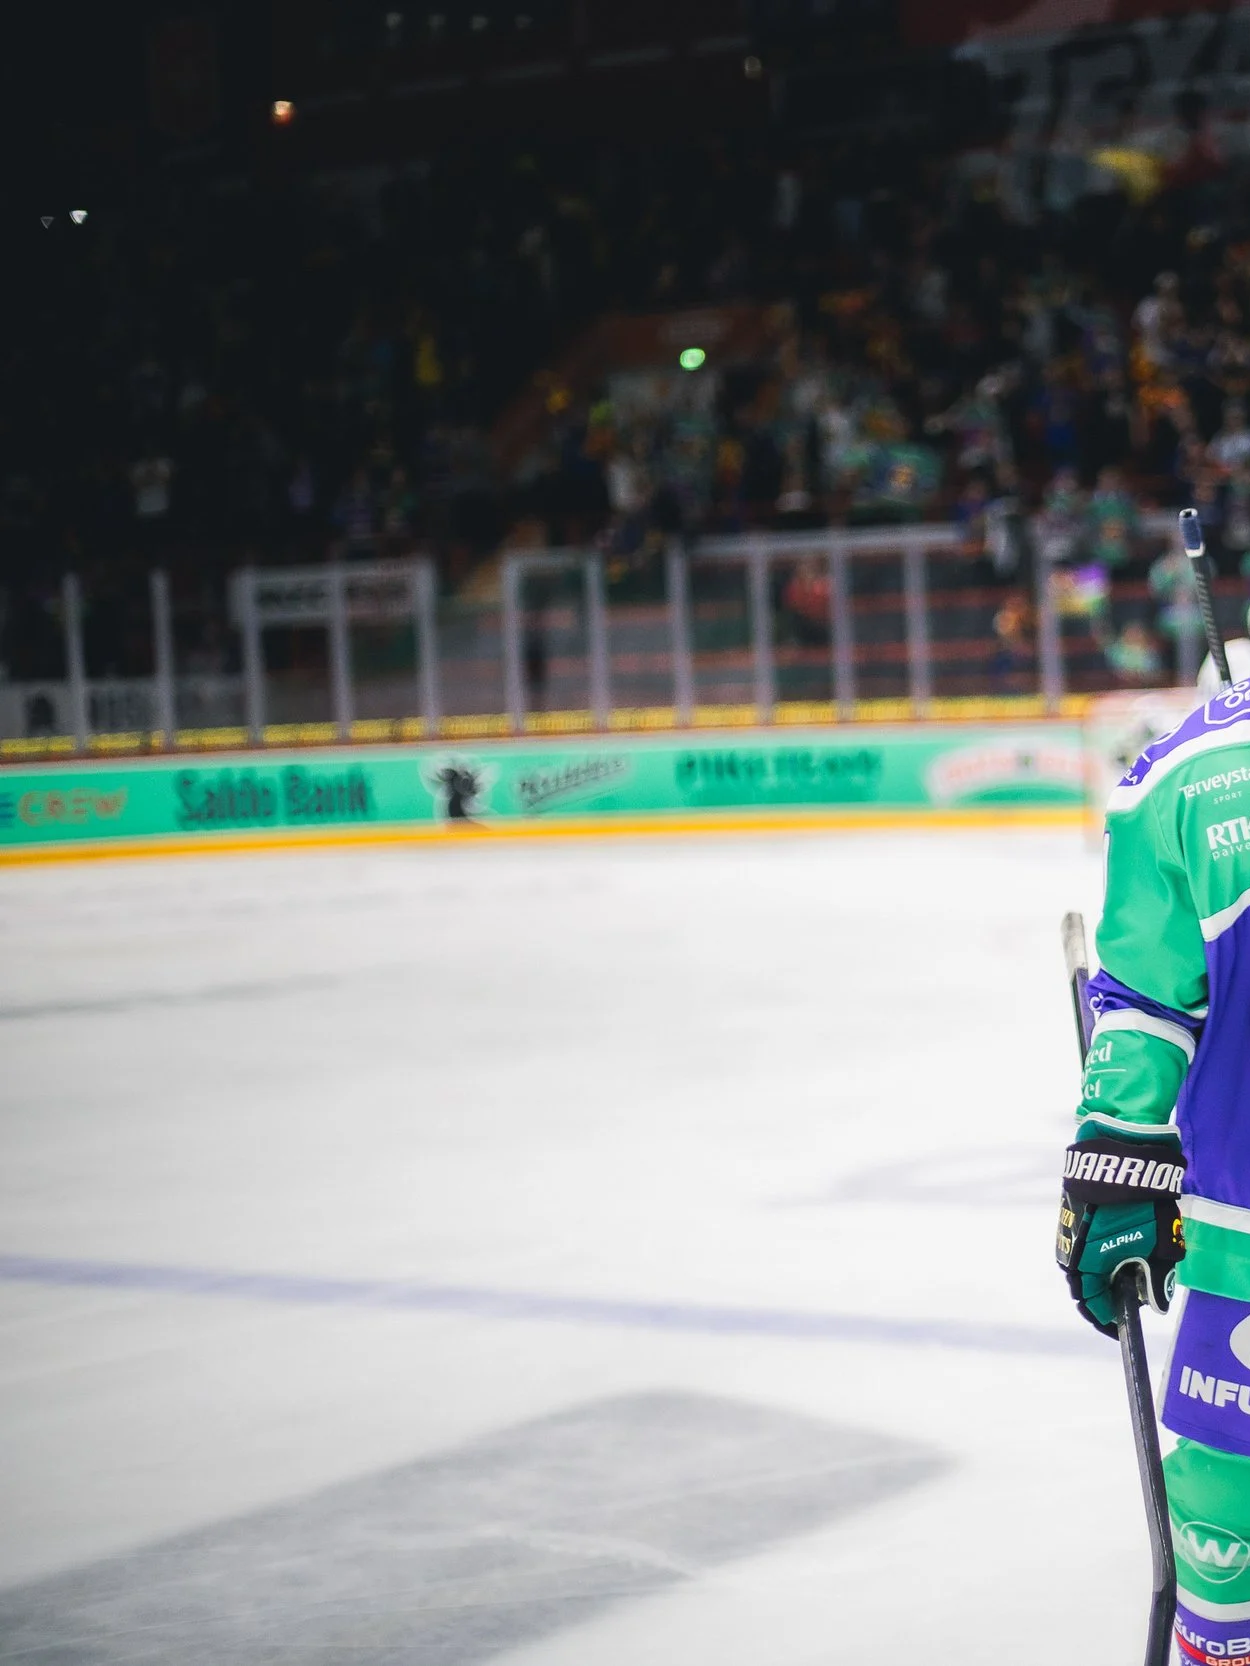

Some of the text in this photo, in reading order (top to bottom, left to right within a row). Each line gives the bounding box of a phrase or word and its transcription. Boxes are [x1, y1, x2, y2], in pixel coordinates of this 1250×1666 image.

[1213, 791, 1243, 804] SPORT
[1062, 1149, 1187, 1194] WARRIOR
[1099, 1231, 1144, 1254] ALPHA
